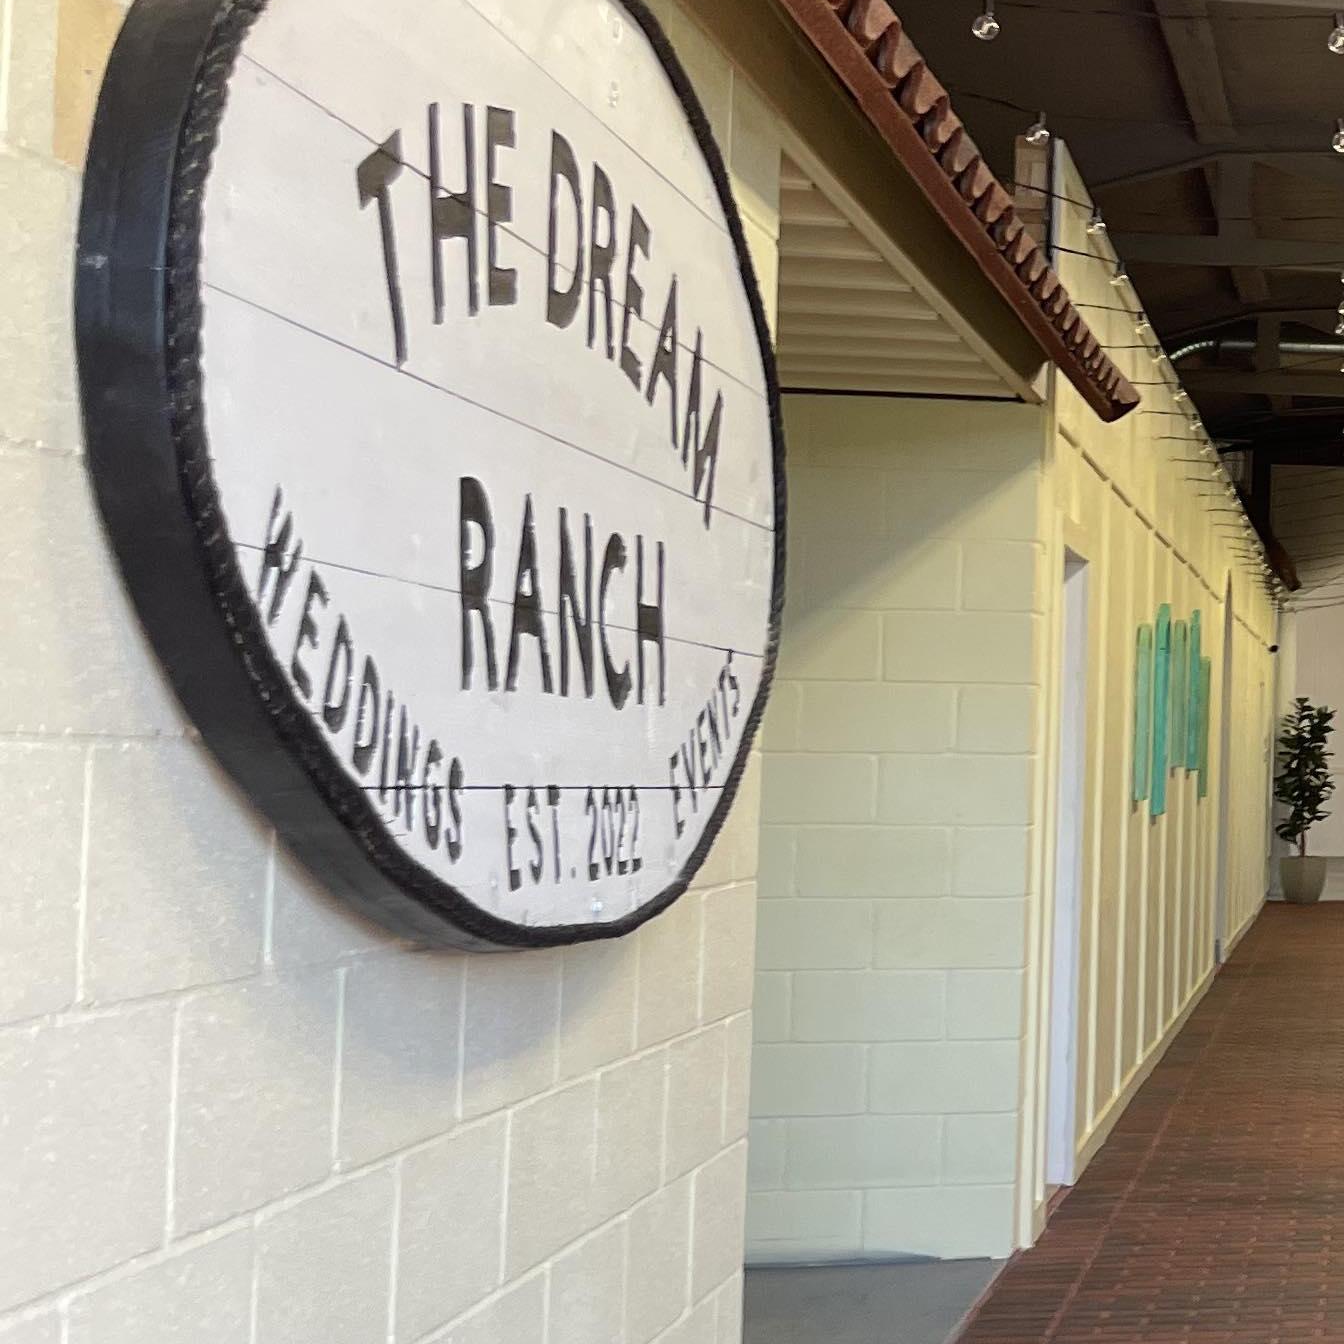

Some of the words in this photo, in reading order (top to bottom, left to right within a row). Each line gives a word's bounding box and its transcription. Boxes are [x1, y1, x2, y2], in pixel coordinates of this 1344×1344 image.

[357, 102, 517, 372] THE
[546, 128, 725, 531] DREAM
[257, 483, 465, 864] WEDDINGS
[585, 783, 643, 882] 2022
[669, 648, 741, 840] EVENTS
[458, 475, 666, 711] RANCH
